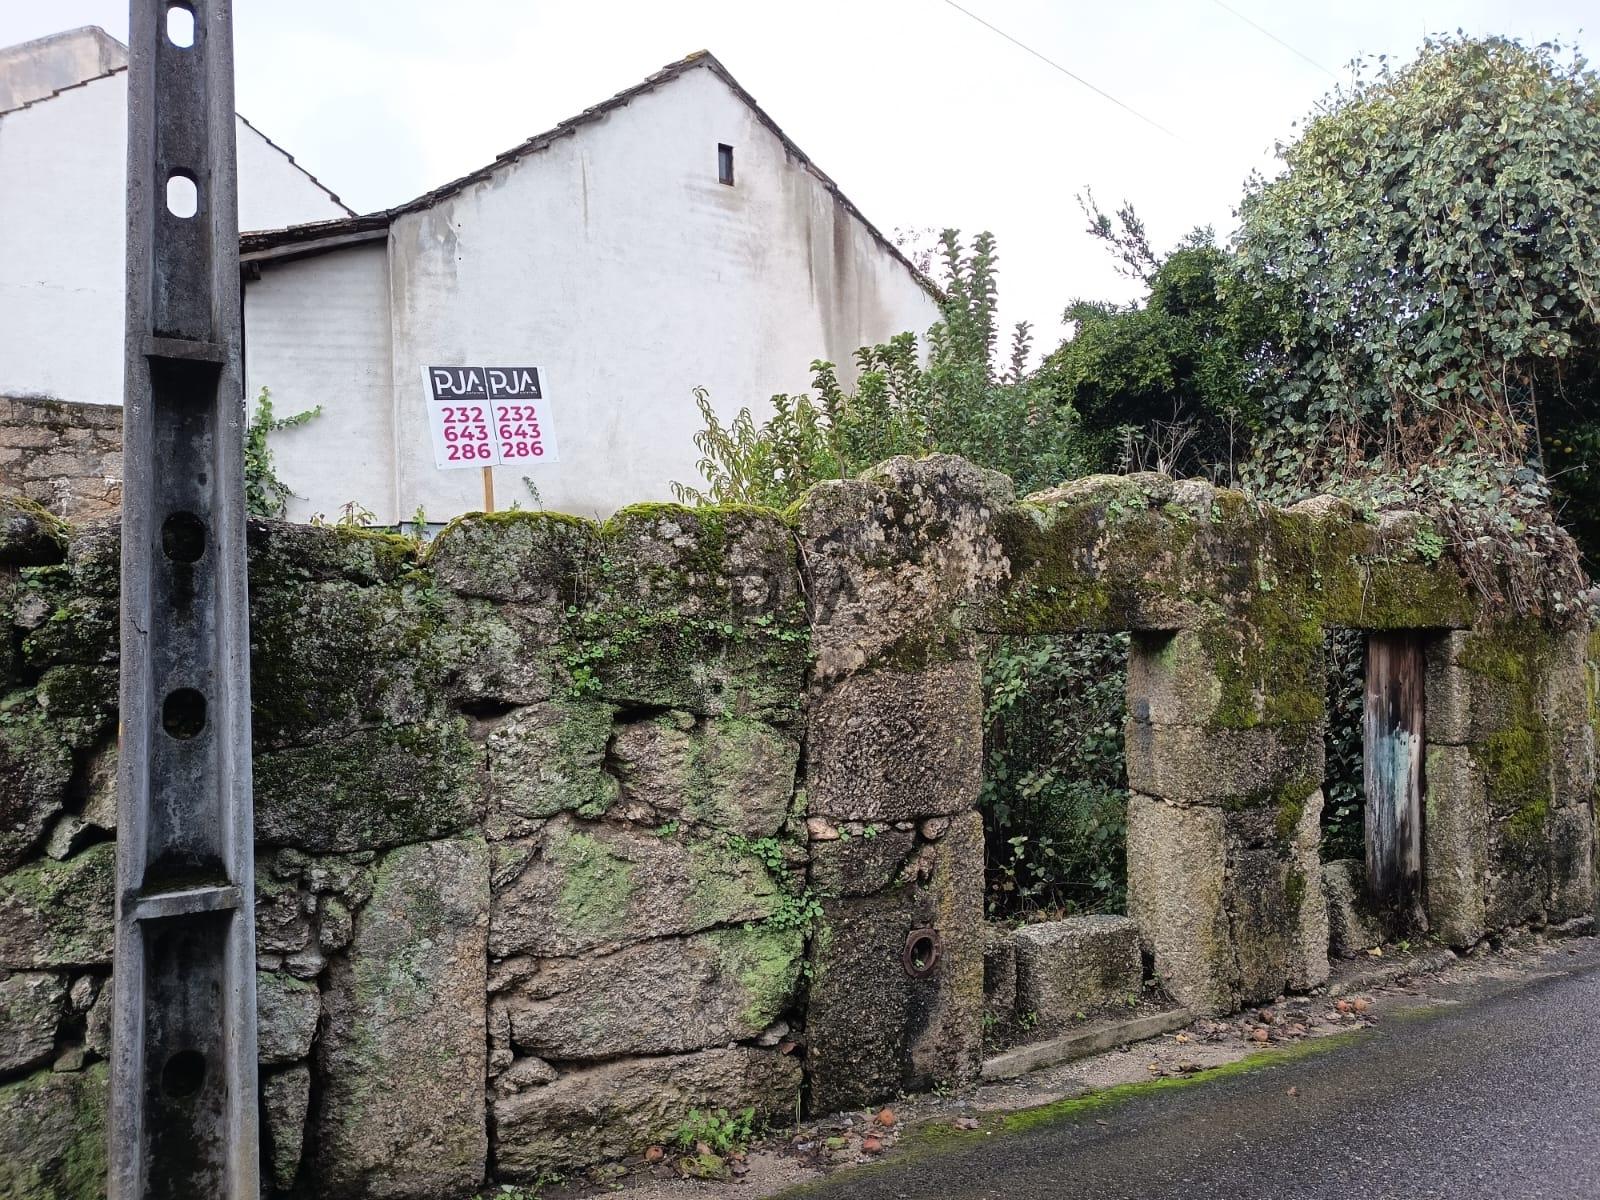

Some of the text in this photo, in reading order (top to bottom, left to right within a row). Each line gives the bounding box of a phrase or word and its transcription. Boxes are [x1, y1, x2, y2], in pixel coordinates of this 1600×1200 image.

[434, 369, 484, 395] PJA
[489, 370, 537, 394] PJA
[441, 407, 485, 423] 232
[497, 406, 537, 421] 232
[444, 425, 488, 441] 643
[500, 424, 541, 439] 643
[446, 443, 491, 460] 286
[502, 441, 543, 457] 286
